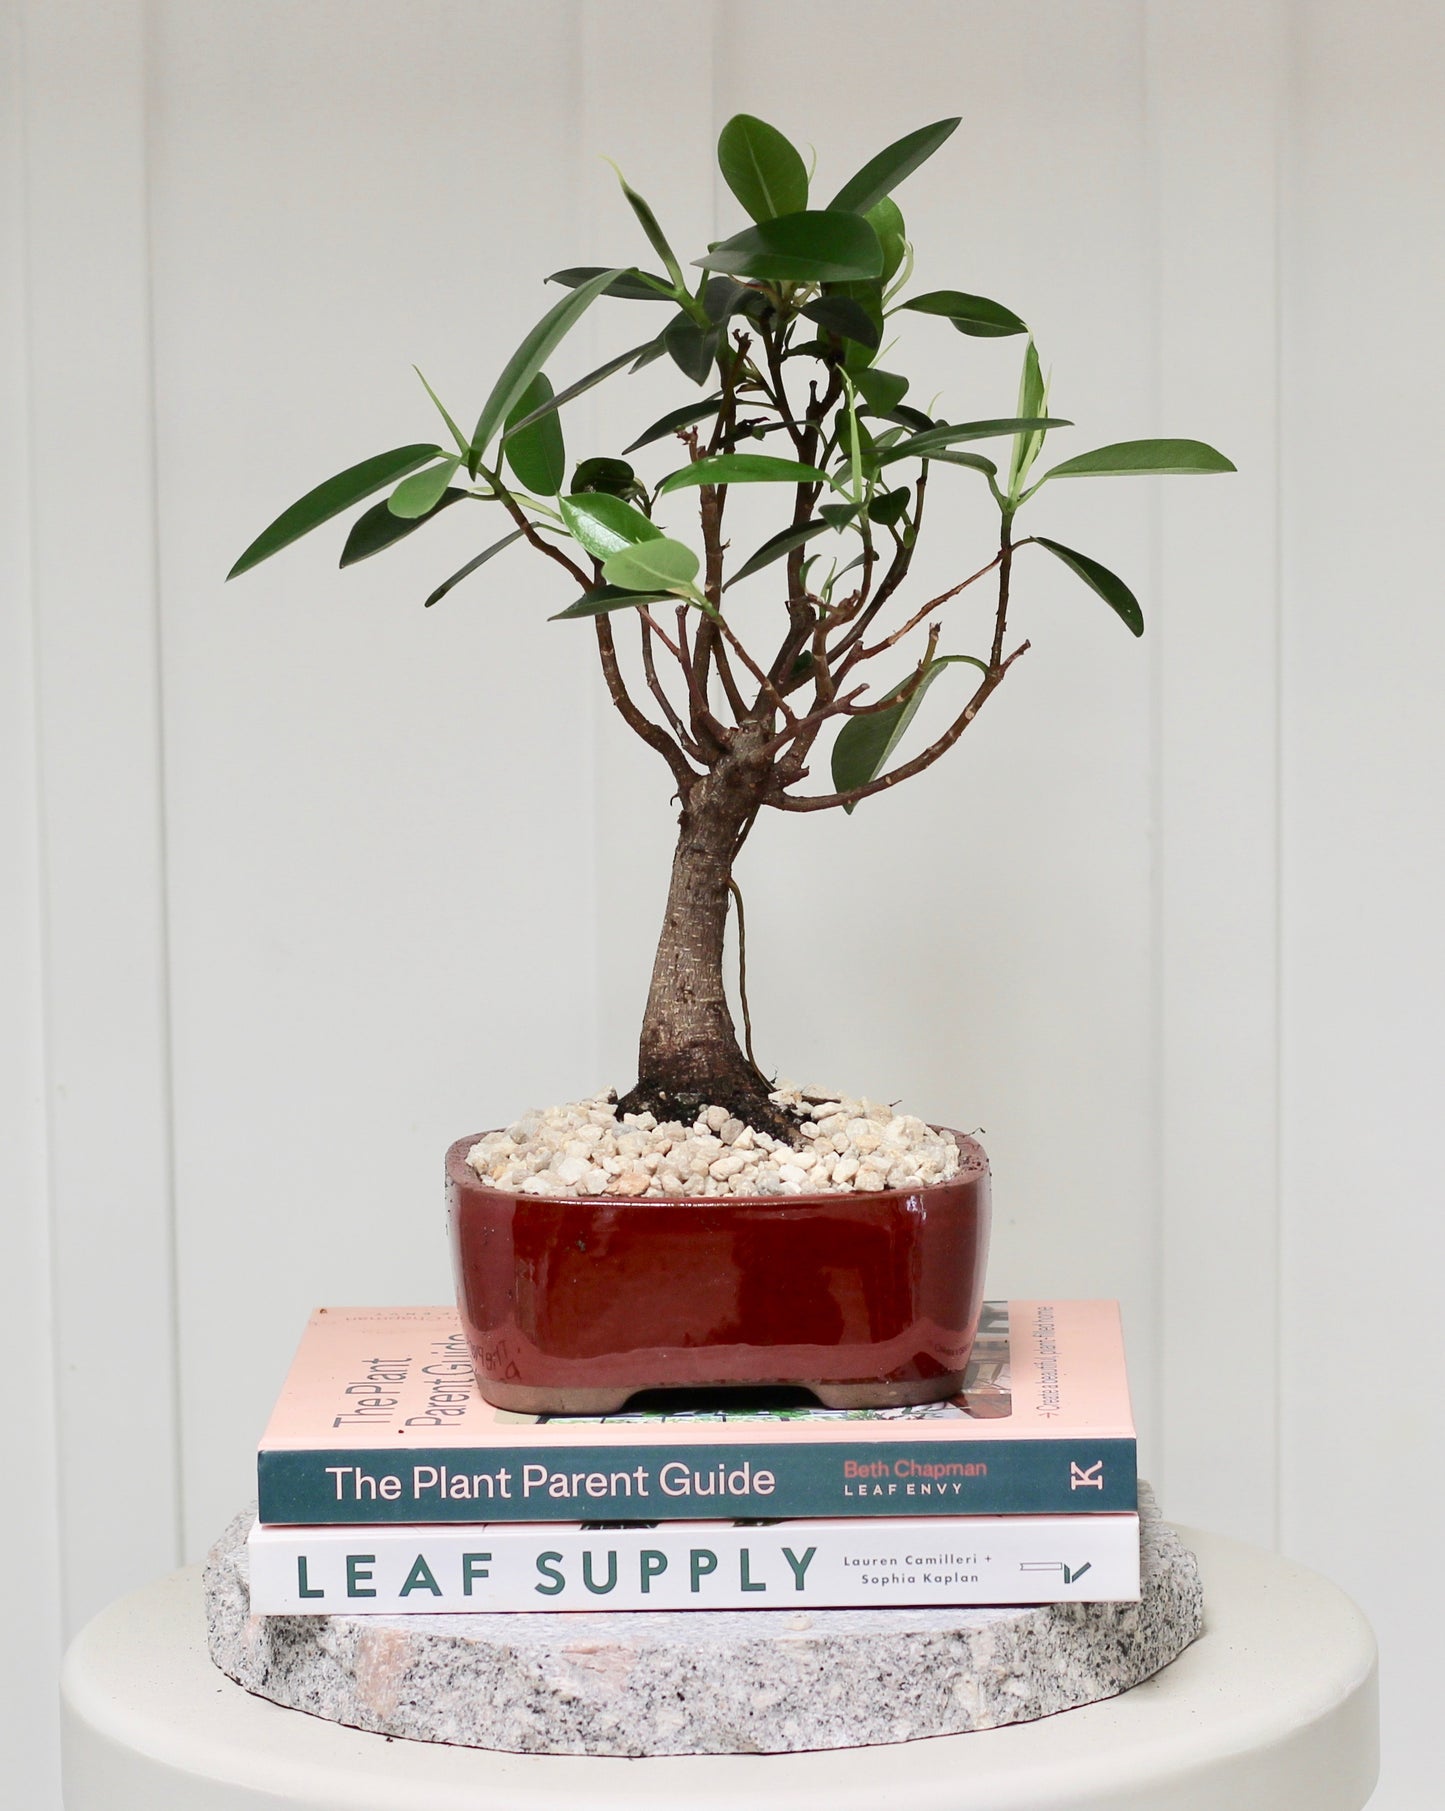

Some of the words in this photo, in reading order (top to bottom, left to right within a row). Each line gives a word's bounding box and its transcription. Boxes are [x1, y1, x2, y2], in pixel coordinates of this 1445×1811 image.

[345, 1358, 412, 1394] Plant
[332, 1398, 398, 1428] The
[405, 1378, 475, 1426] Parent
[325, 1466, 401, 1500] The
[412, 1465, 511, 1499] Plant
[523, 1464, 648, 1498] Parent
[659, 1461, 776, 1496] Guide
[844, 1460, 890, 1478] Beth
[894, 1460, 987, 1479] Chapman
[1070, 1460, 1103, 1490] K
[845, 1484, 897, 1496] LEAF
[906, 1483, 962, 1495] ENVY
[298, 1552, 491, 1599] LEAF
[535, 1547, 817, 1597] SUPPLY
[844, 1556, 897, 1567] Lauren
[905, 1554, 977, 1565] Camilleri
[862, 1574, 916, 1586] Sophia
[923, 1572, 979, 1586] Kaplan
